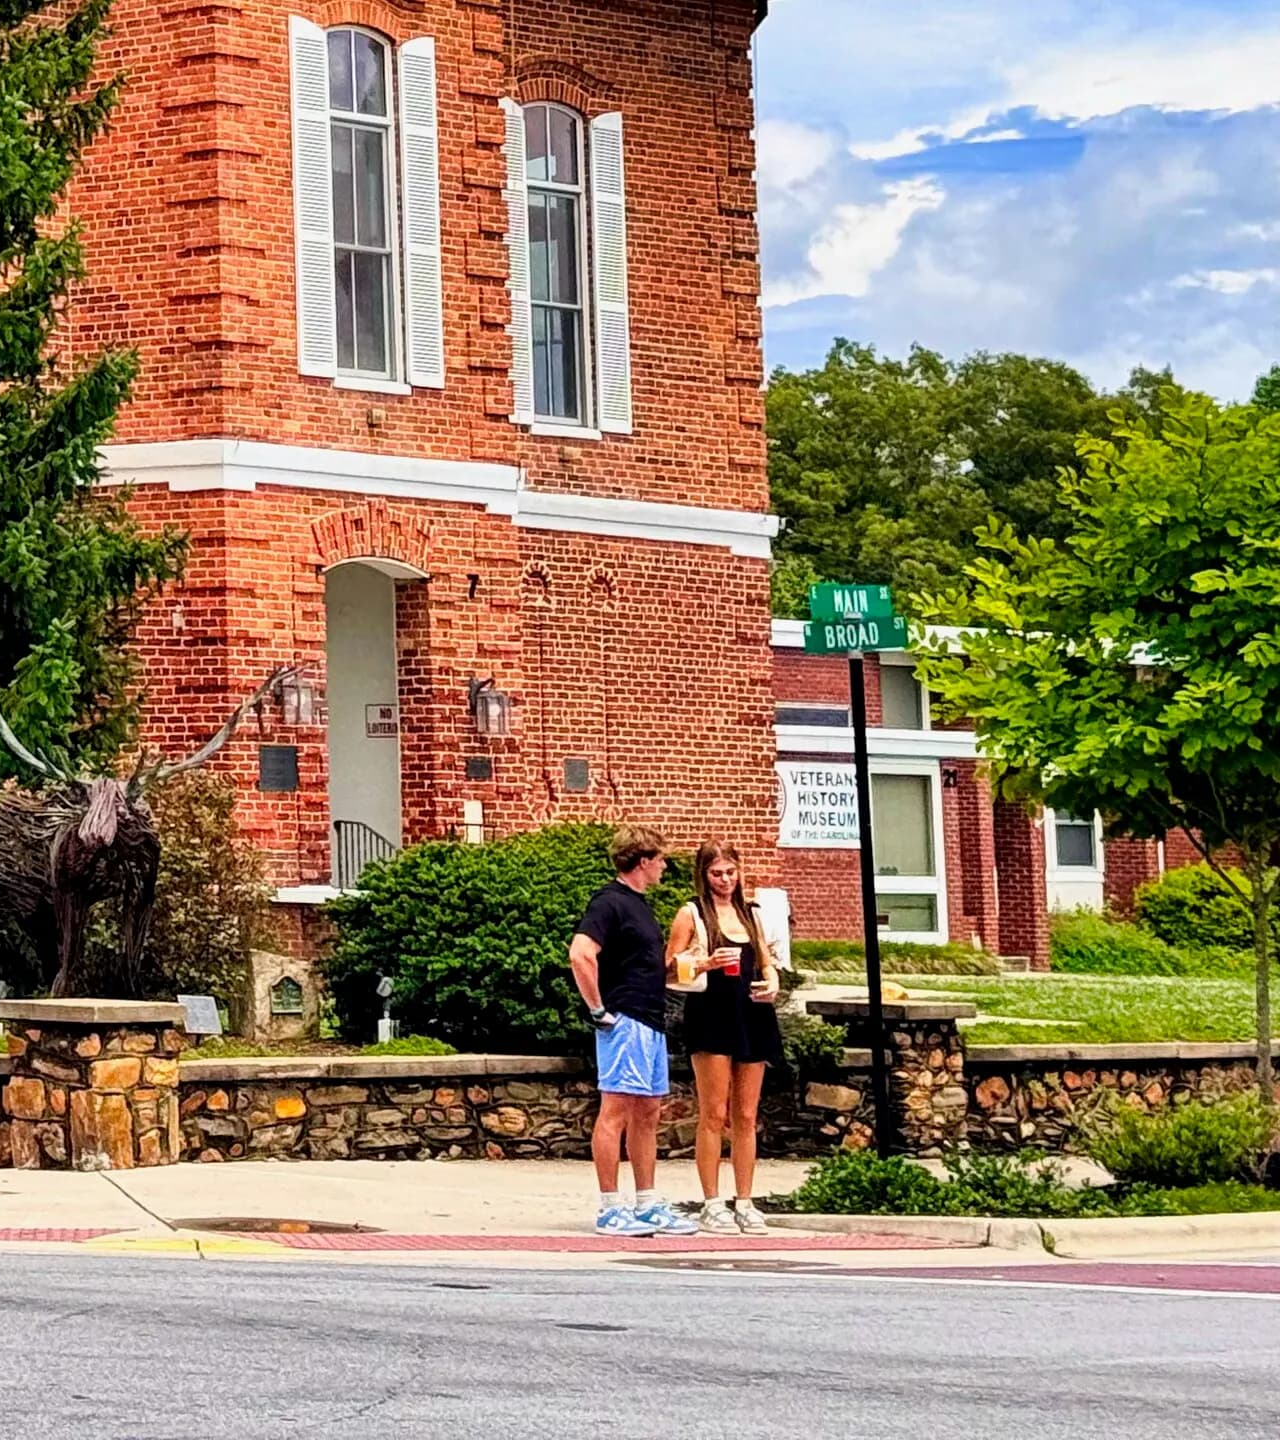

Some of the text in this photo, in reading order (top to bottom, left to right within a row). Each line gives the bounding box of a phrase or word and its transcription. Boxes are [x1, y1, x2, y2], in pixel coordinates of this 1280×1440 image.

[833, 589, 868, 612] MAIN
[824, 621, 880, 649] BROAD
[893, 616, 905, 630] ST
[379, 707, 392, 719] NO
[797, 791, 855, 807] HISTORY
[798, 811, 857, 828] MUSEUM
[791, 829, 801, 839] OF
[820, 830, 860, 841] CAROLINA
